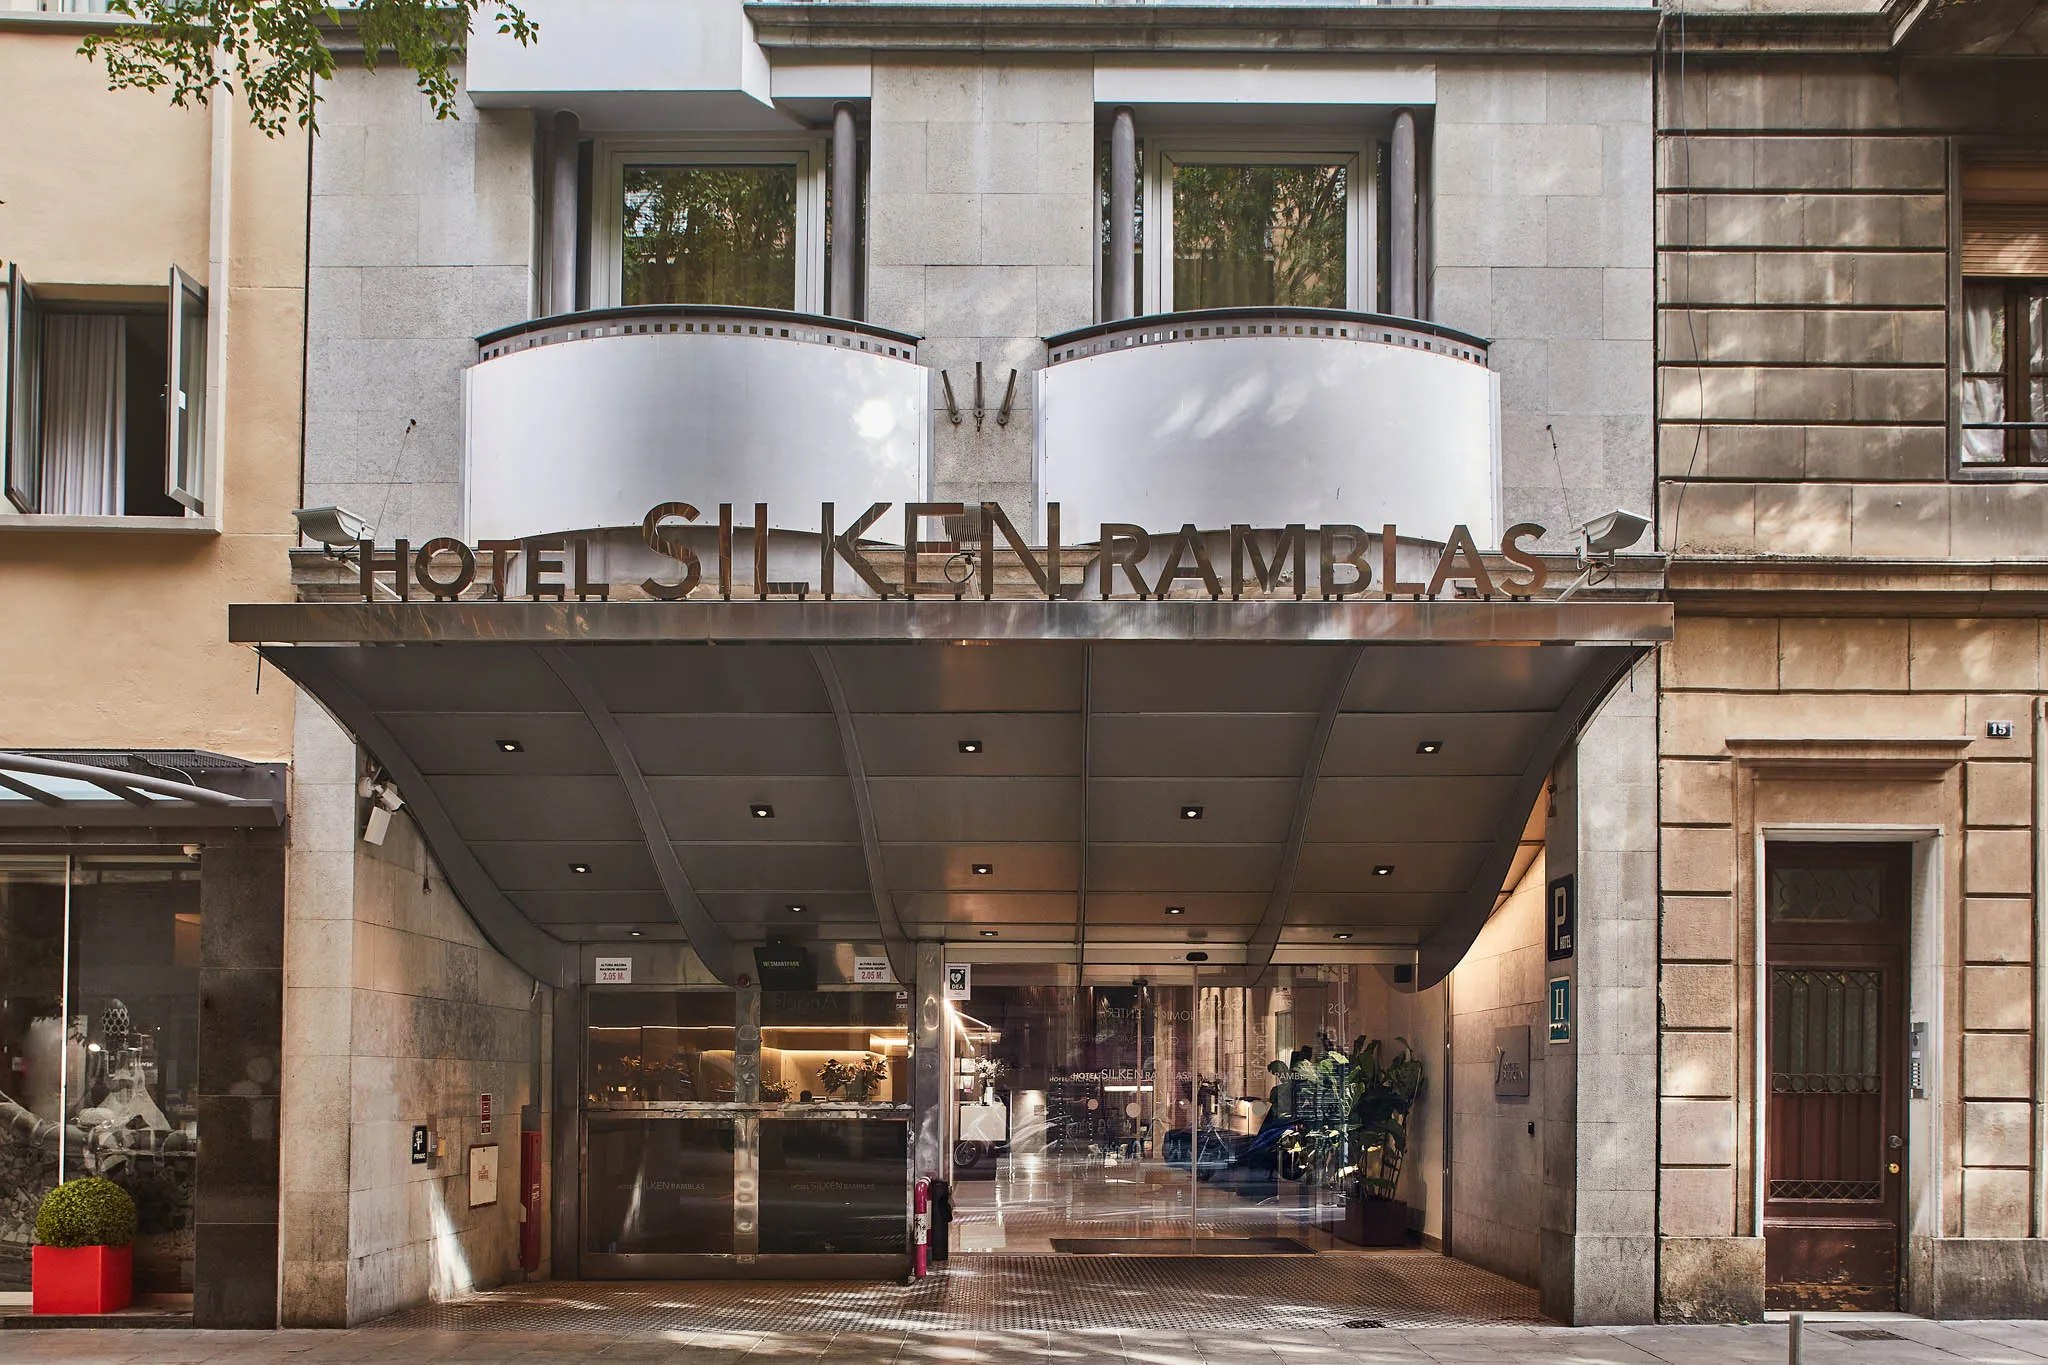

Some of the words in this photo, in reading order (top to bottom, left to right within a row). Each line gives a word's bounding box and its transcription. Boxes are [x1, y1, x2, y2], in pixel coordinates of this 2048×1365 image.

[360, 537, 609, 597] HOTEL
[641, 502, 1060, 599] SILKEN
[1101, 523, 1548, 598] RAMBLAS
[1992, 723, 2006, 735] 15
[1555, 887, 1567, 951] P
[603, 972, 616, 980] 2.05
[861, 971, 875, 980] 2.05
[1555, 988, 1565, 1020] H
[1100, 1069, 1142, 1080] SILKEN
